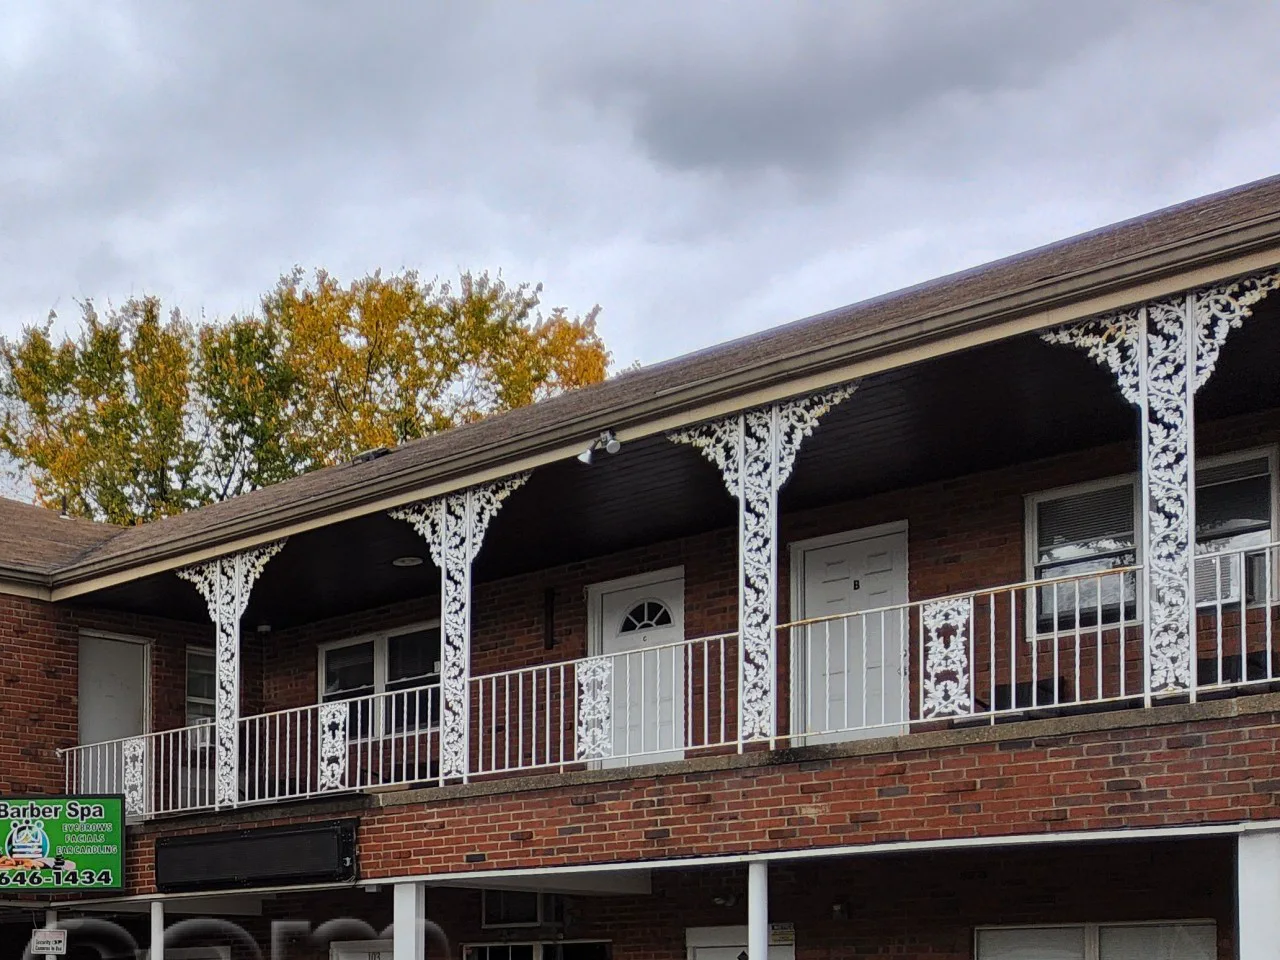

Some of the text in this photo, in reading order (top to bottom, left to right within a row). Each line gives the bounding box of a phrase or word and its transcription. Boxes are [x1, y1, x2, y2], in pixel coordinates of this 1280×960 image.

[853, 579, 860, 591] B
[67, 801, 103, 822] Spa
[65, 834, 105, 843] FACIALS
